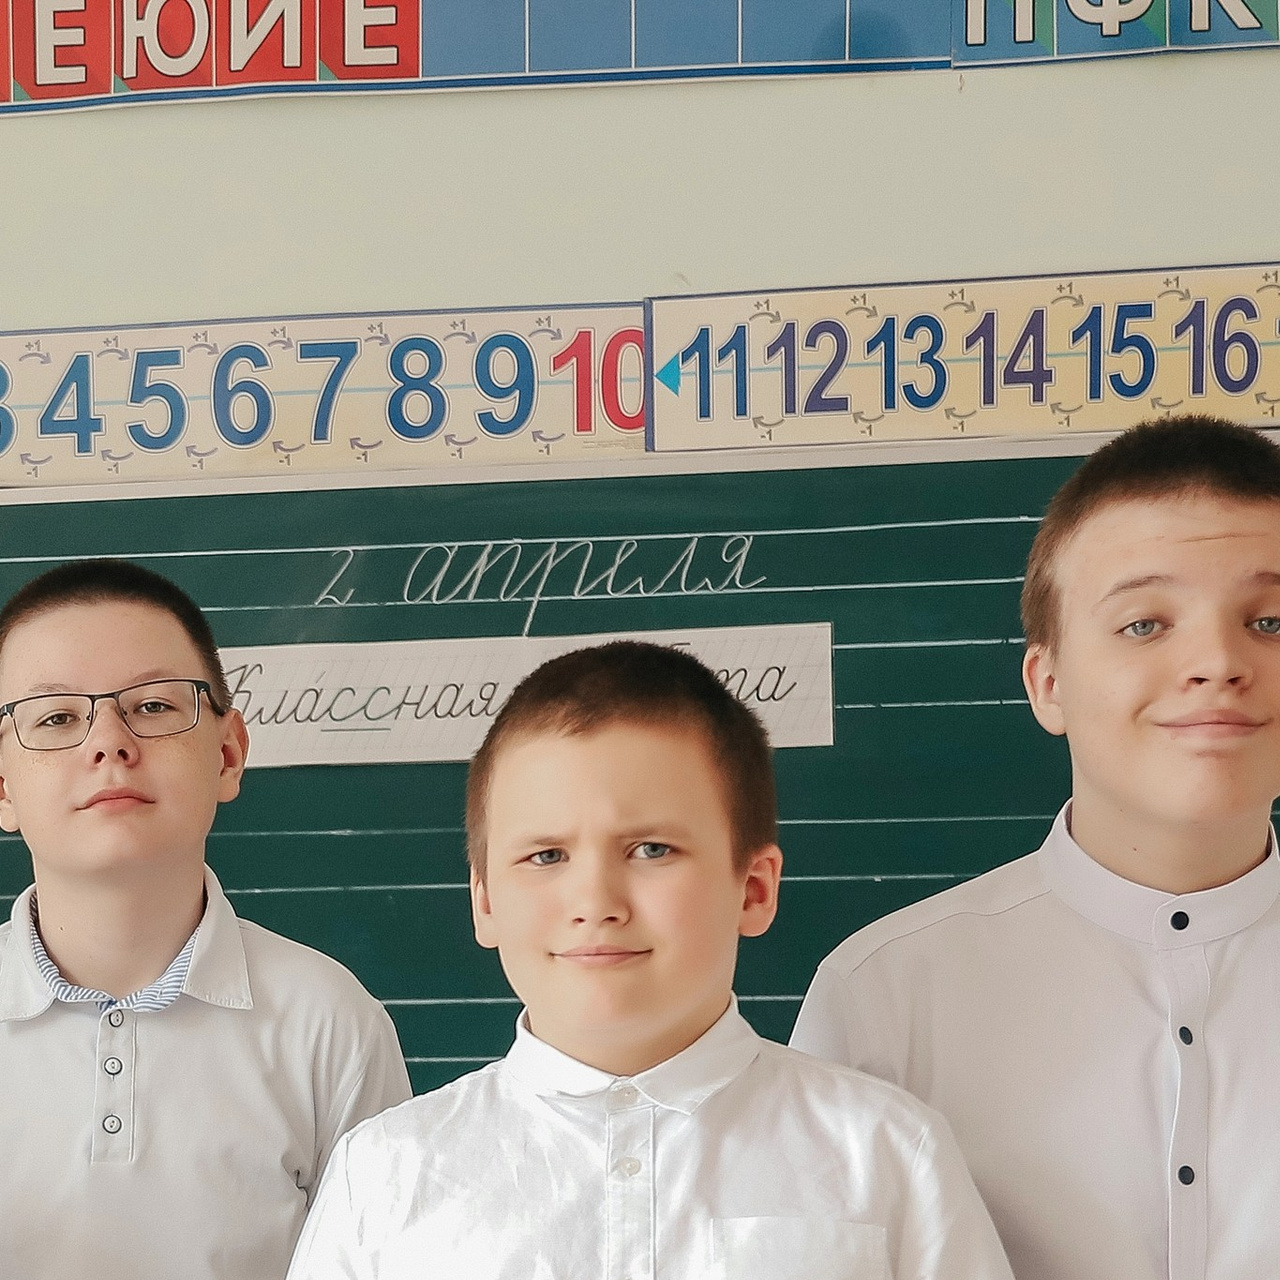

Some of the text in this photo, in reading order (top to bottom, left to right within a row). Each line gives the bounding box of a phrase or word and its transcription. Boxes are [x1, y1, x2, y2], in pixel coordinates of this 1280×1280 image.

[122, 0, 209, 79] Ю
[754, 271, 1278, 311] +1 +1 +1 +1 +1 +1
[25, 340, 41, 351] +1
[103, 336, 119, 348] +1
[192, 331, 209, 343] +1
[271, 326, 287, 338] +1
[367, 322, 383, 334] +1
[450, 319, 466, 331] +1
[536, 316, 552, 328] +1
[681, 297, 1259, 418] 11 12 13 14 15 16
[39, 353, 104, 454] 4
[128, 349, 187, 450] 5
[213, 344, 274, 446] 6
[299, 341, 358, 441] 7
[388, 337, 448, 439] 8
[475, 334, 536, 436] 9
[553, 329, 645, 432] 10
[760, 405, 1275, 441] -1 -1 -1 -1 -1
[27, 467, 39, 478] -1
[107, 463, 119, 474] -1
[192, 459, 204, 470] -1
[279, 454, 291, 466] -1
[356, 451, 368, 463] -1
[451, 448, 463, 459] -1
[538, 444, 551, 456] -1
[315, 534, 767, 637] 2 апреля
